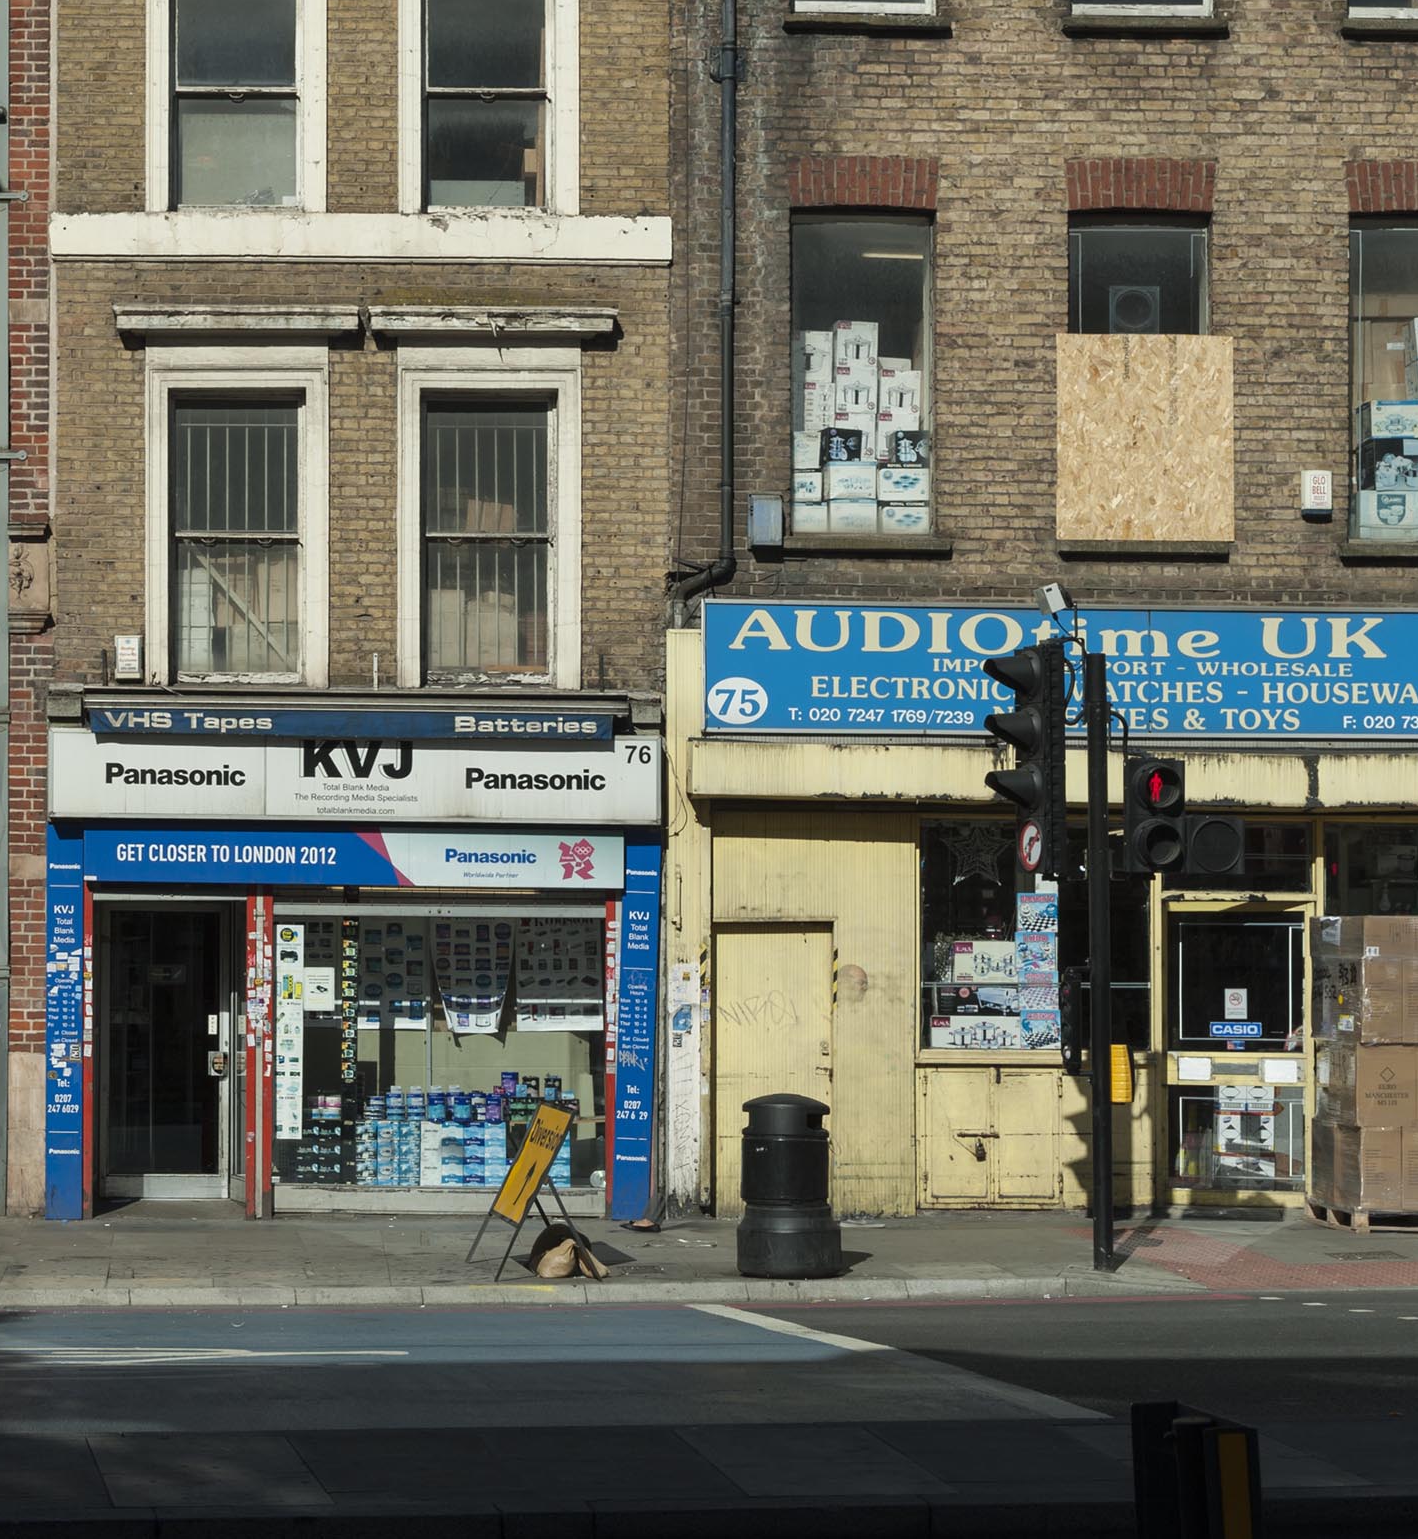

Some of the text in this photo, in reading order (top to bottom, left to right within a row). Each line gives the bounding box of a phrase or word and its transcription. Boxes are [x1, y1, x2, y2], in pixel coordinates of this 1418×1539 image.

[1260, 617, 1387, 660] UK
[1198, 661, 1353, 678] WHOLESALE
[811, 675, 1015, 702] ELECTRONIC
[715, 688, 761, 717] 75
[788, 707, 974, 725] T: 020 7247 1769/7239
[1220, 708, 1300, 731] TOYS
[104, 710, 273, 733] VHS Tapes
[454, 716, 597, 734] Batteries
[1343, 715, 1356, 729] F:
[1363, 715, 1395, 729] 020
[299, 739, 413, 780] KVJ
[625, 745, 652, 764] 76
[105, 762, 246, 787] Panasonic
[465, 767, 606, 791] Panasonic
[323, 783, 390, 792] Total Blank Media
[294, 793, 418, 803] The Recording Media Specialists
[316, 806, 395, 815] totalblankmedia.com
[116, 843, 337, 865] GET CLOSER TO LONDON 2012
[445, 848, 537, 865] Panasonic
[463, 871, 494, 879] Worldwide
[53, 904, 75, 914] KVJ
[629, 911, 650, 920] KVJ
[55, 917, 73, 925] Total
[630, 923, 648, 931] Total
[628, 933, 649, 941] Blank
[628, 942, 649, 950] Media
[1211, 1024, 1258, 1035] CASIO
[57, 1078, 70, 1088] Tel:
[626, 1084, 640, 1094] Tel:
[54, 1094, 72, 1102] 0207
[47, 1104, 79, 1113] 247 6029
[623, 1100, 641, 1109] 0207
[616, 1110, 629, 1119] 247
[616, 1154, 647, 1162] Panasonic
